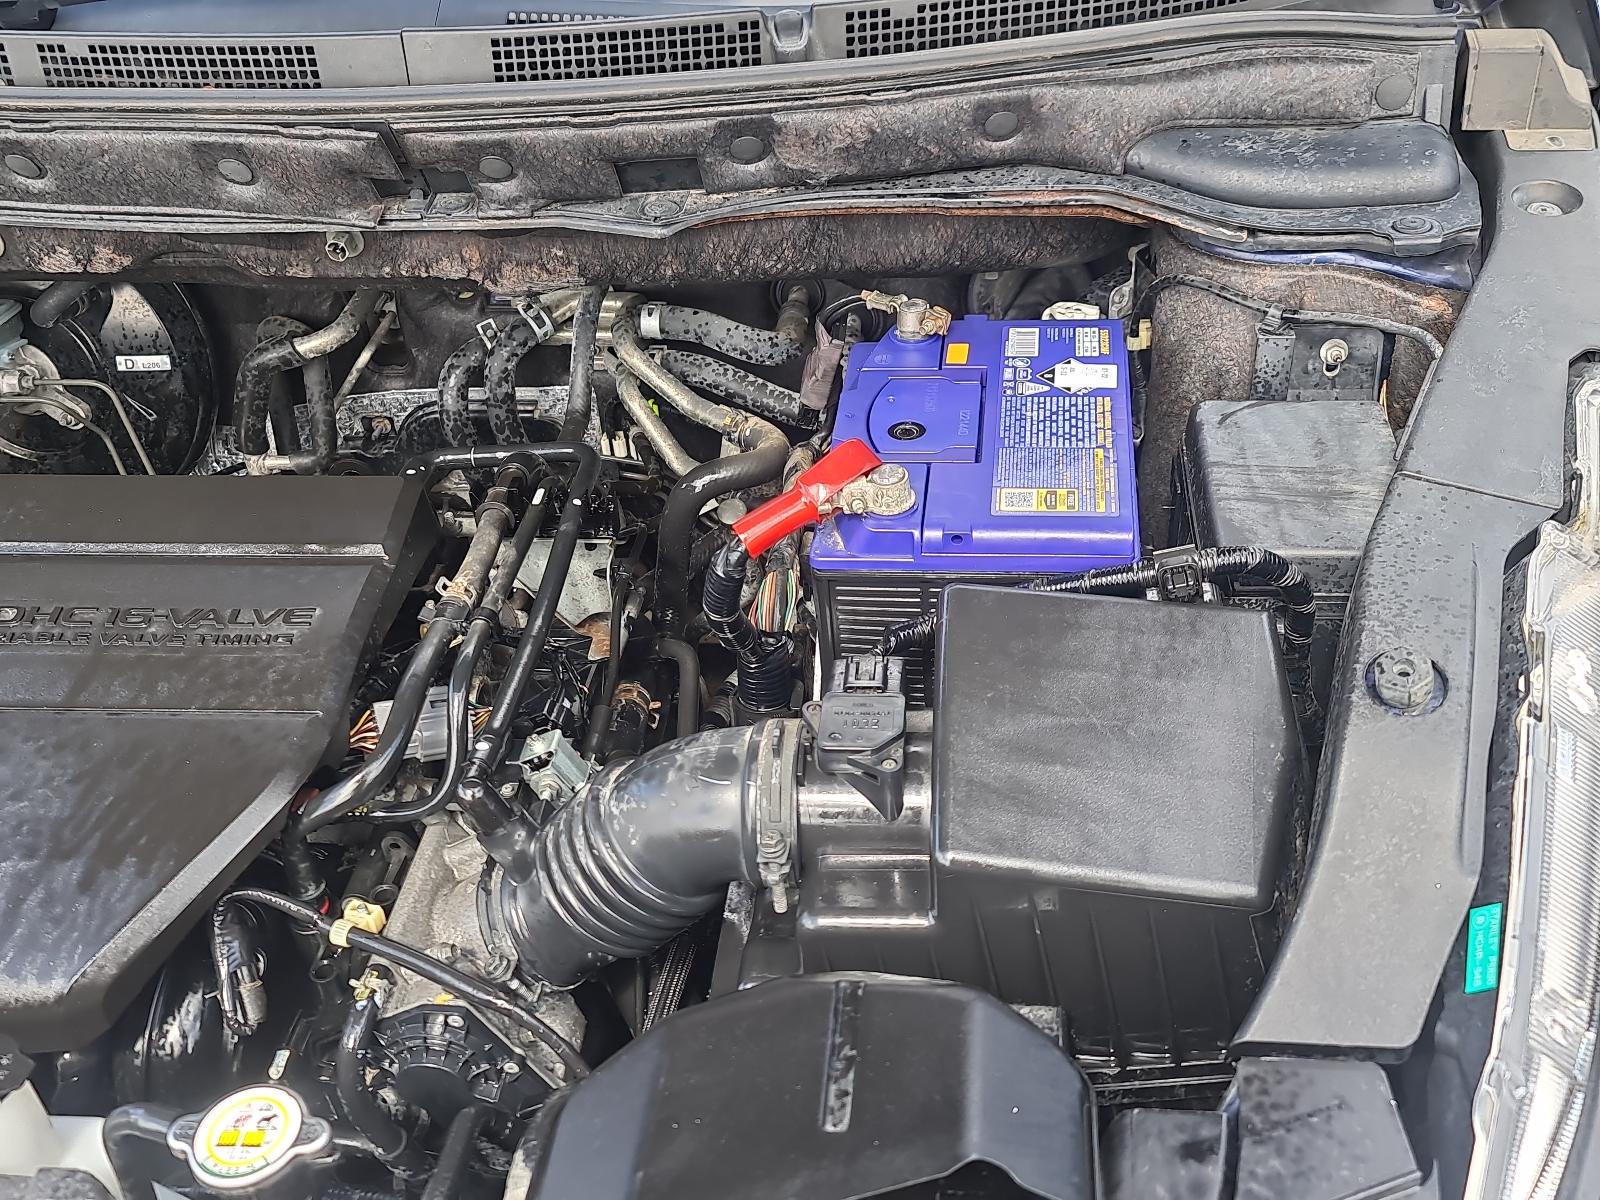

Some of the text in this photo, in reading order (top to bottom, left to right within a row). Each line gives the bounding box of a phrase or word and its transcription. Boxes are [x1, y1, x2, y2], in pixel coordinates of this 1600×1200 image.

[124, 359, 134, 369] D
[104, 606, 318, 629] 16-VALVE
[100, 632, 187, 647] VALVE
[197, 633, 295, 647] TIMING
